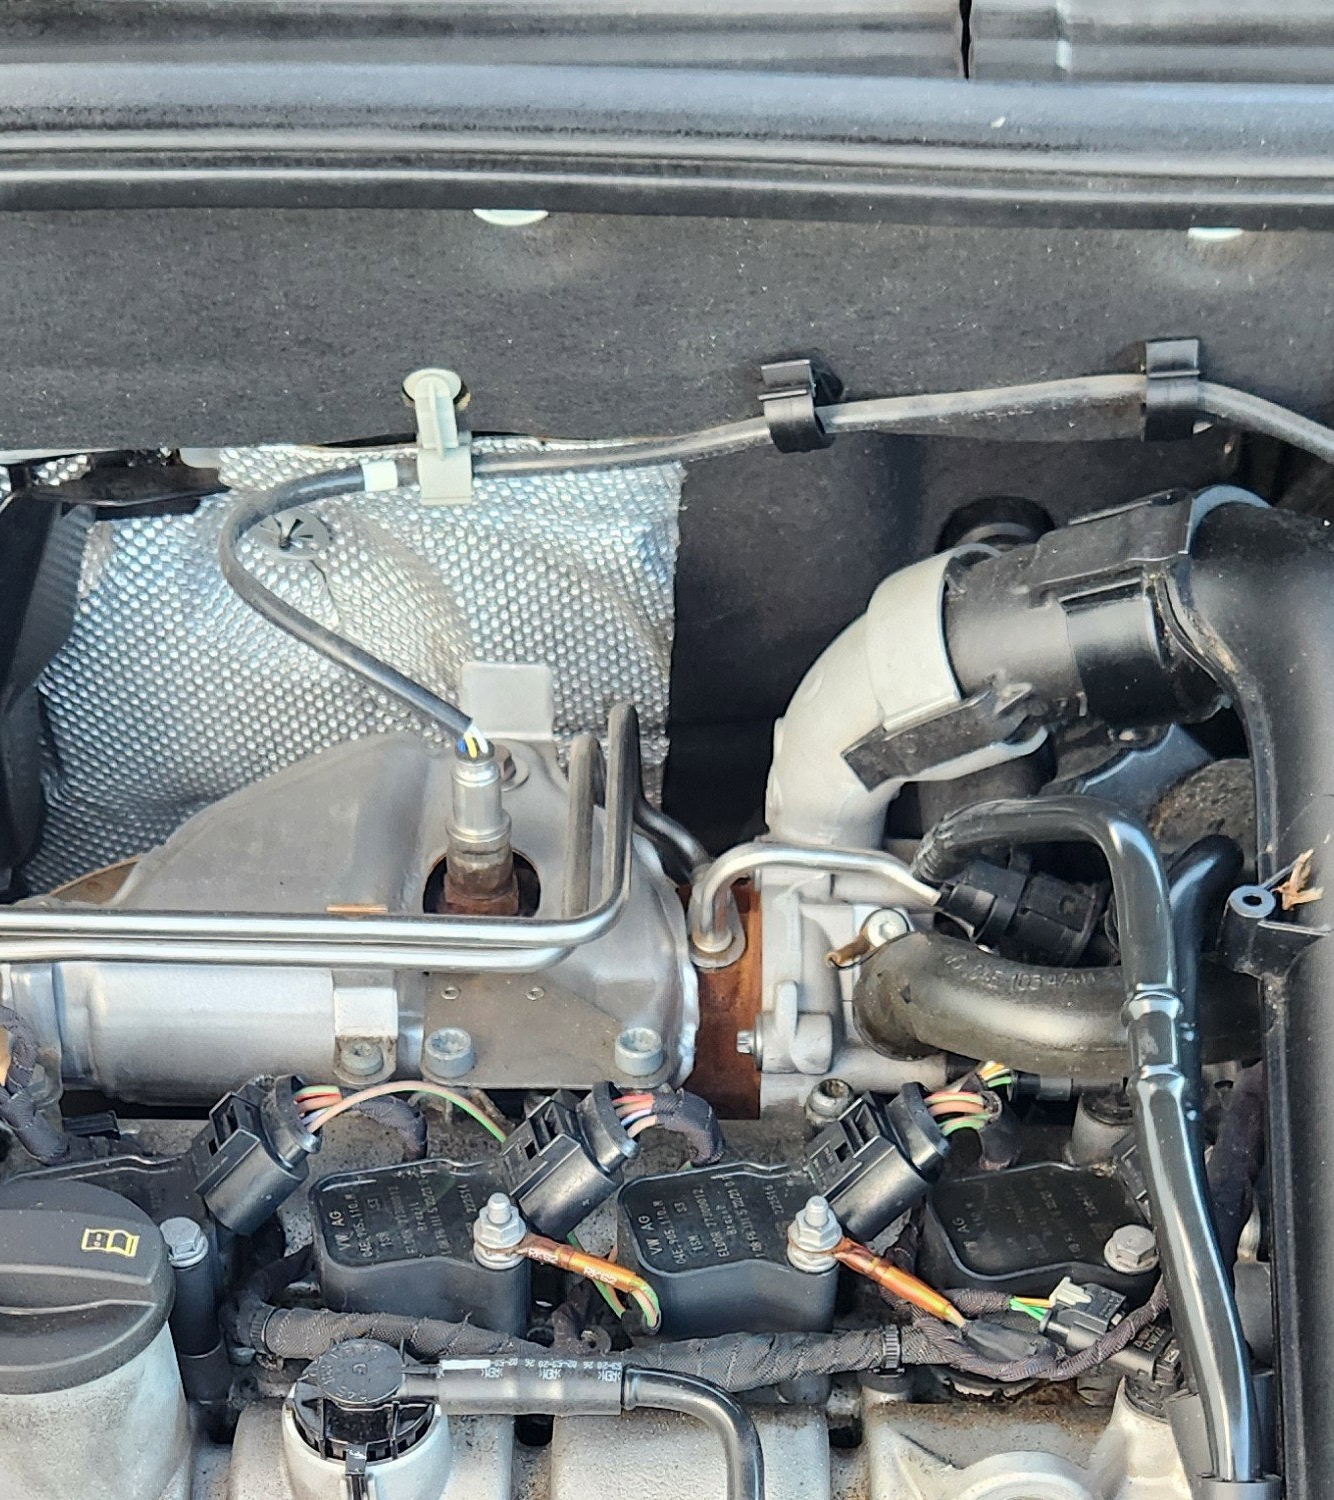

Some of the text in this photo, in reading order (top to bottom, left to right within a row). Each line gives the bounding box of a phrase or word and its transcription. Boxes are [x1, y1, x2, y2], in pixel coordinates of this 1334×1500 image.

[327, 1211, 353, 1250] VW AG
[637, 1214, 663, 1254] VW AG
